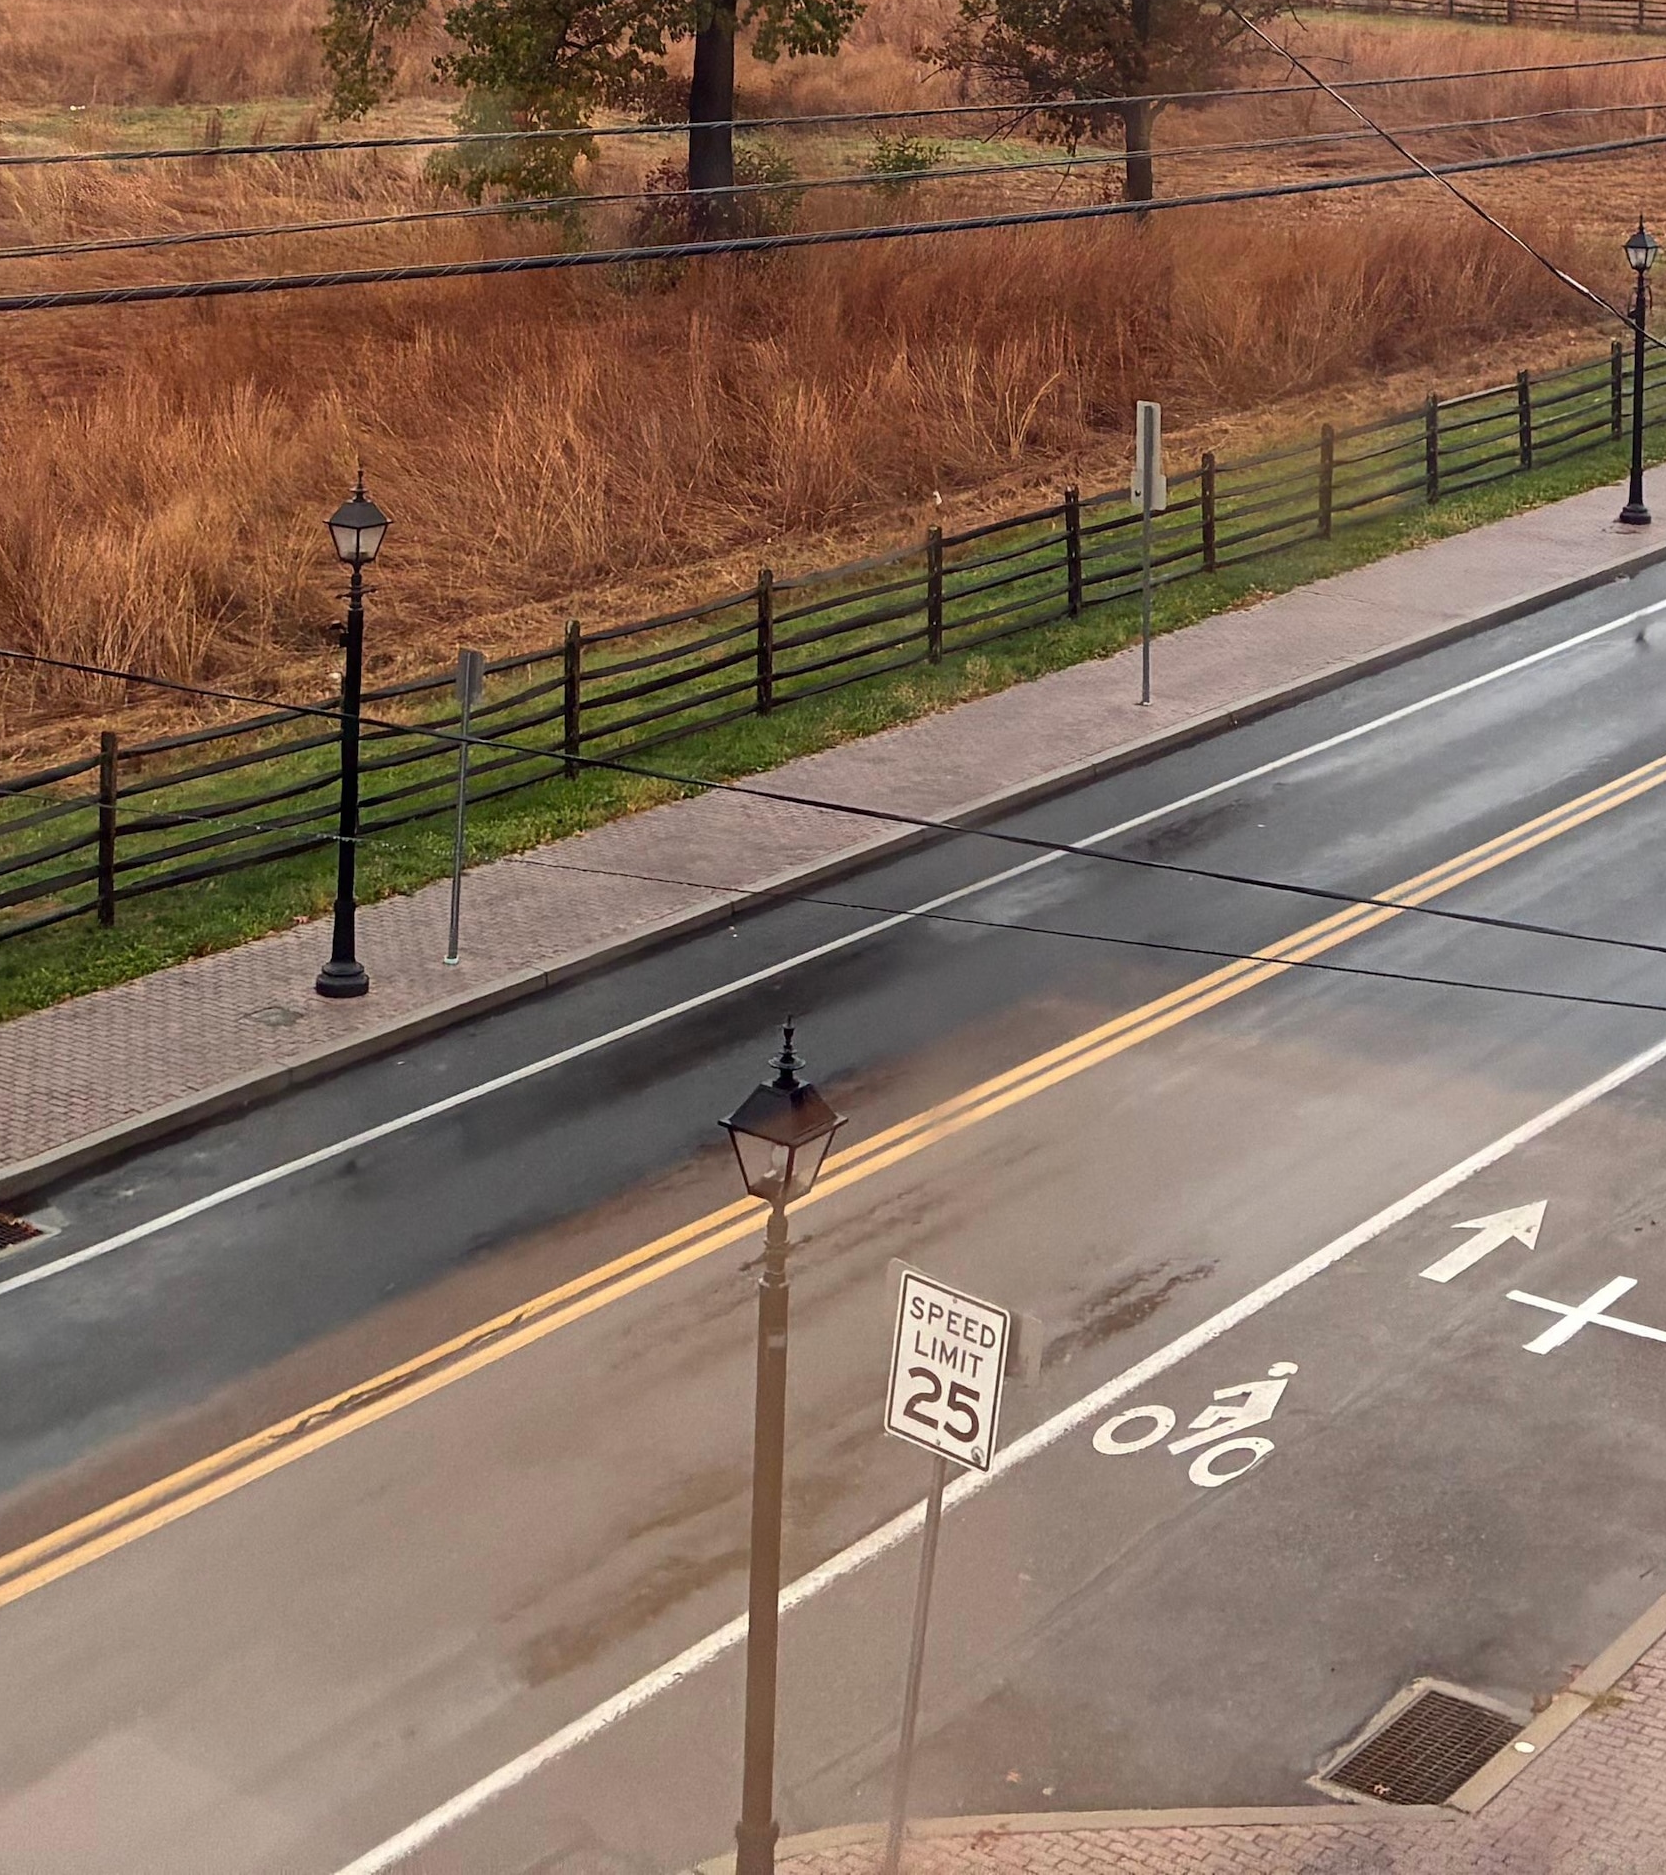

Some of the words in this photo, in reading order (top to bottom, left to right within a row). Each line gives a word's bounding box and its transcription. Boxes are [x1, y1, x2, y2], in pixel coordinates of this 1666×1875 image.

[909, 1296, 996, 1349] SPEED
[914, 1330, 983, 1378] LIMIT
[903, 1366, 981, 1443] 25
